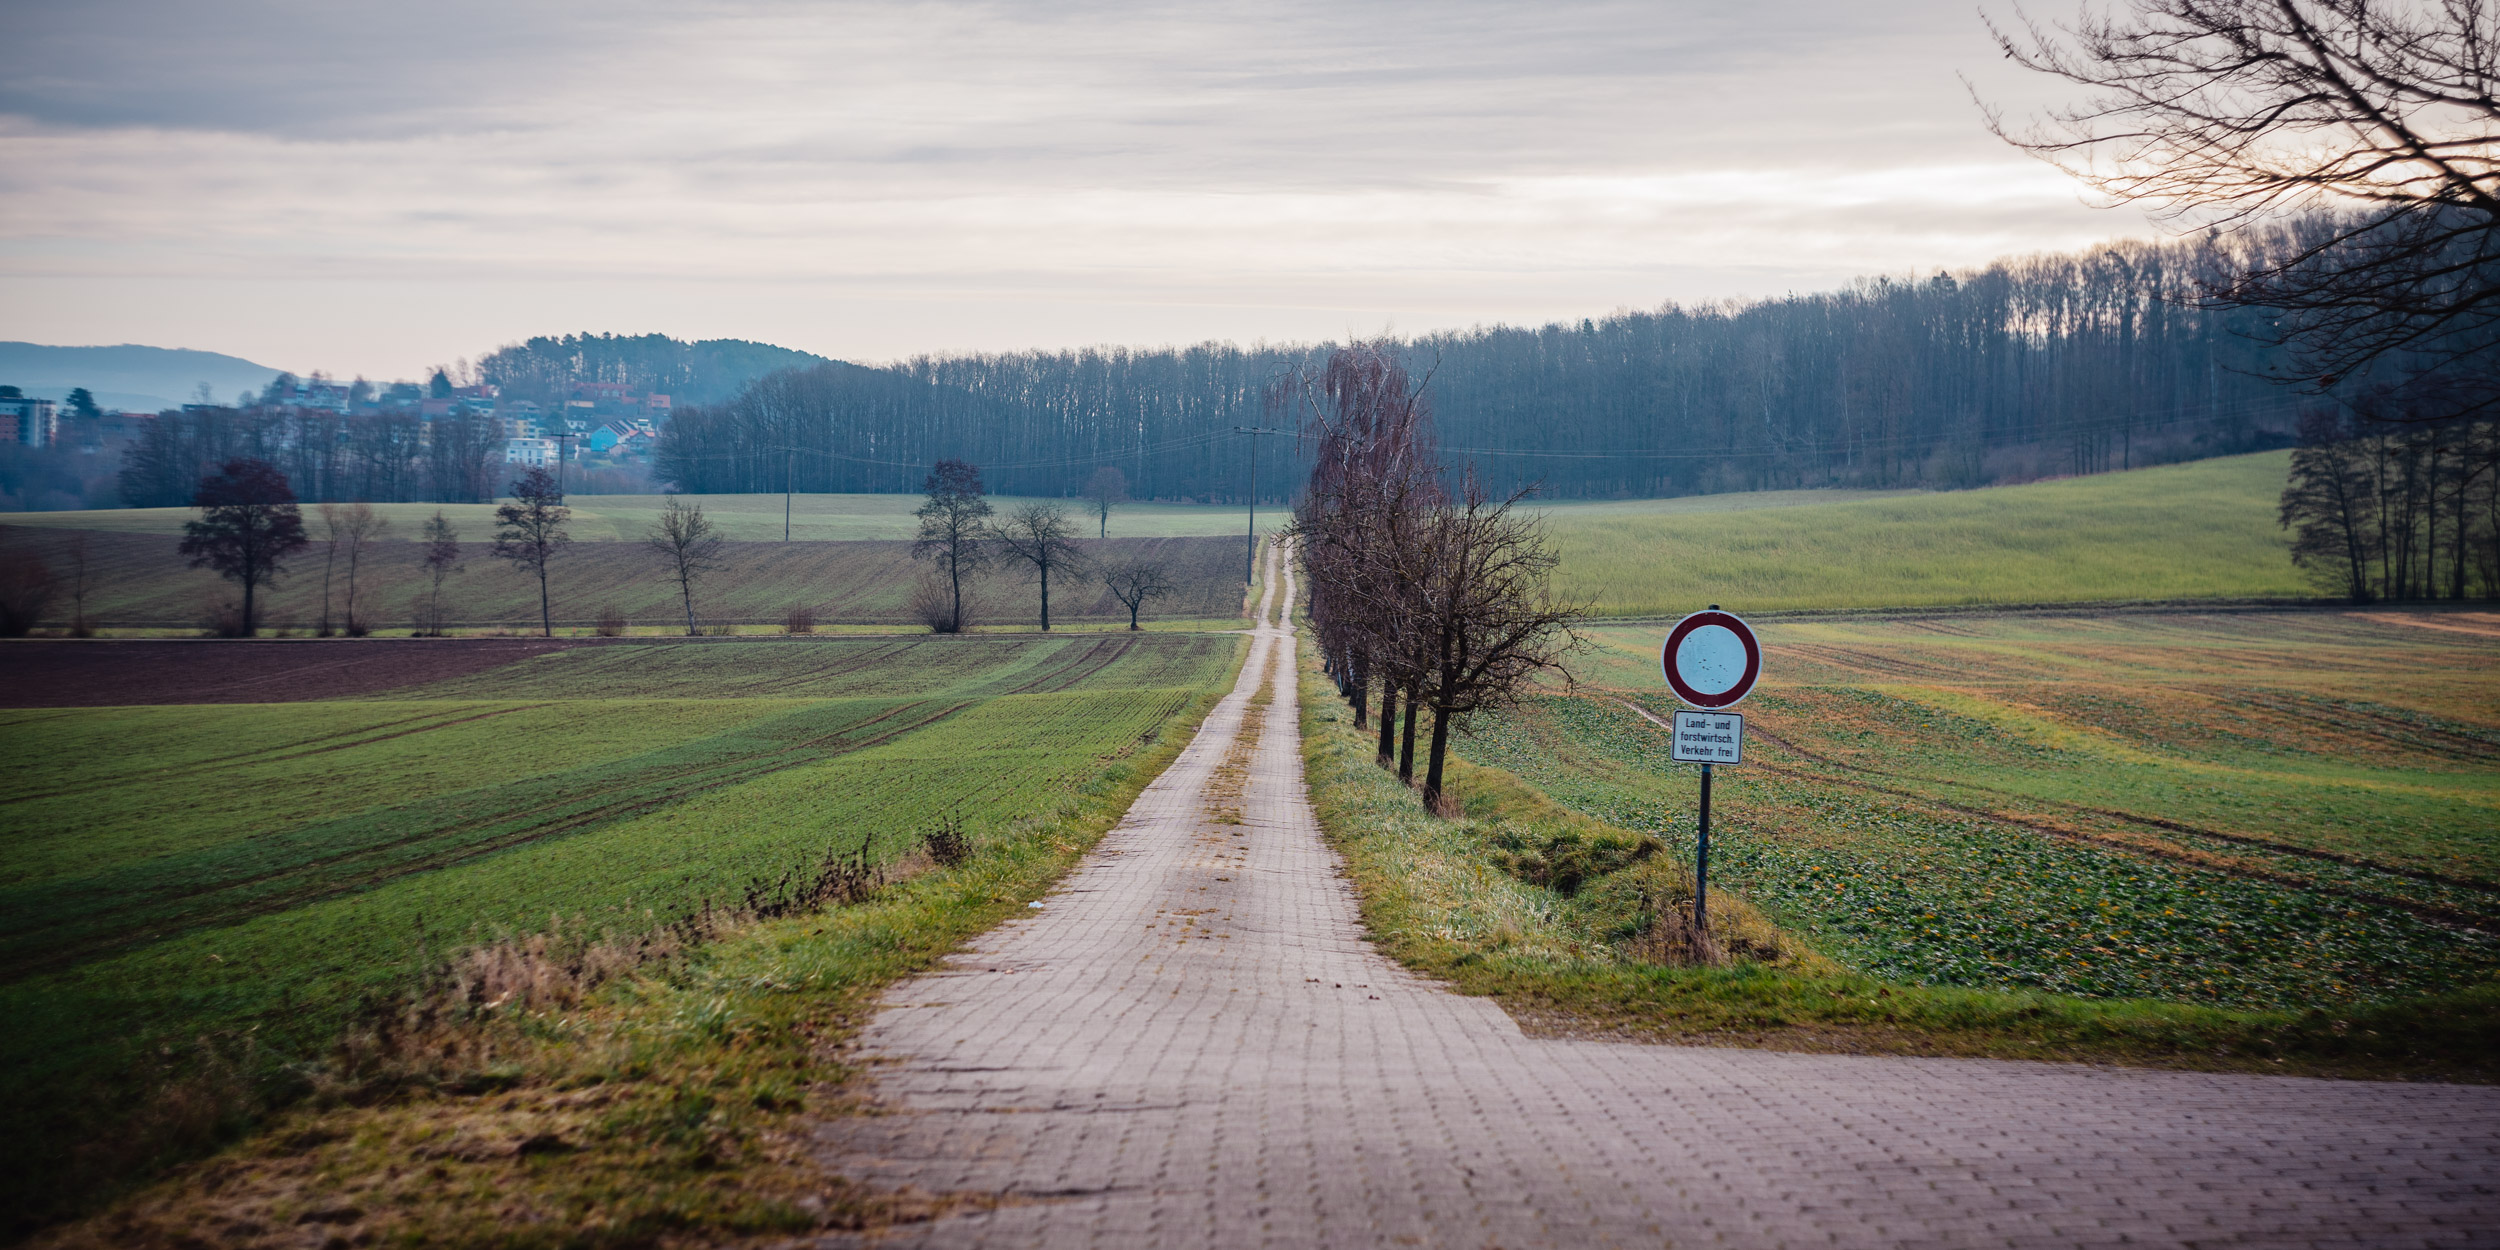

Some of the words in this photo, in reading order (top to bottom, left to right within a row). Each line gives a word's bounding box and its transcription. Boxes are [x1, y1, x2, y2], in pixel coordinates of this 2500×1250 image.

[1685, 718, 1711, 728] Land-
[1715, 720, 1731, 730] und
[1681, 745, 1714, 756] Verkehr
[1718, 747, 1734, 757] frei
